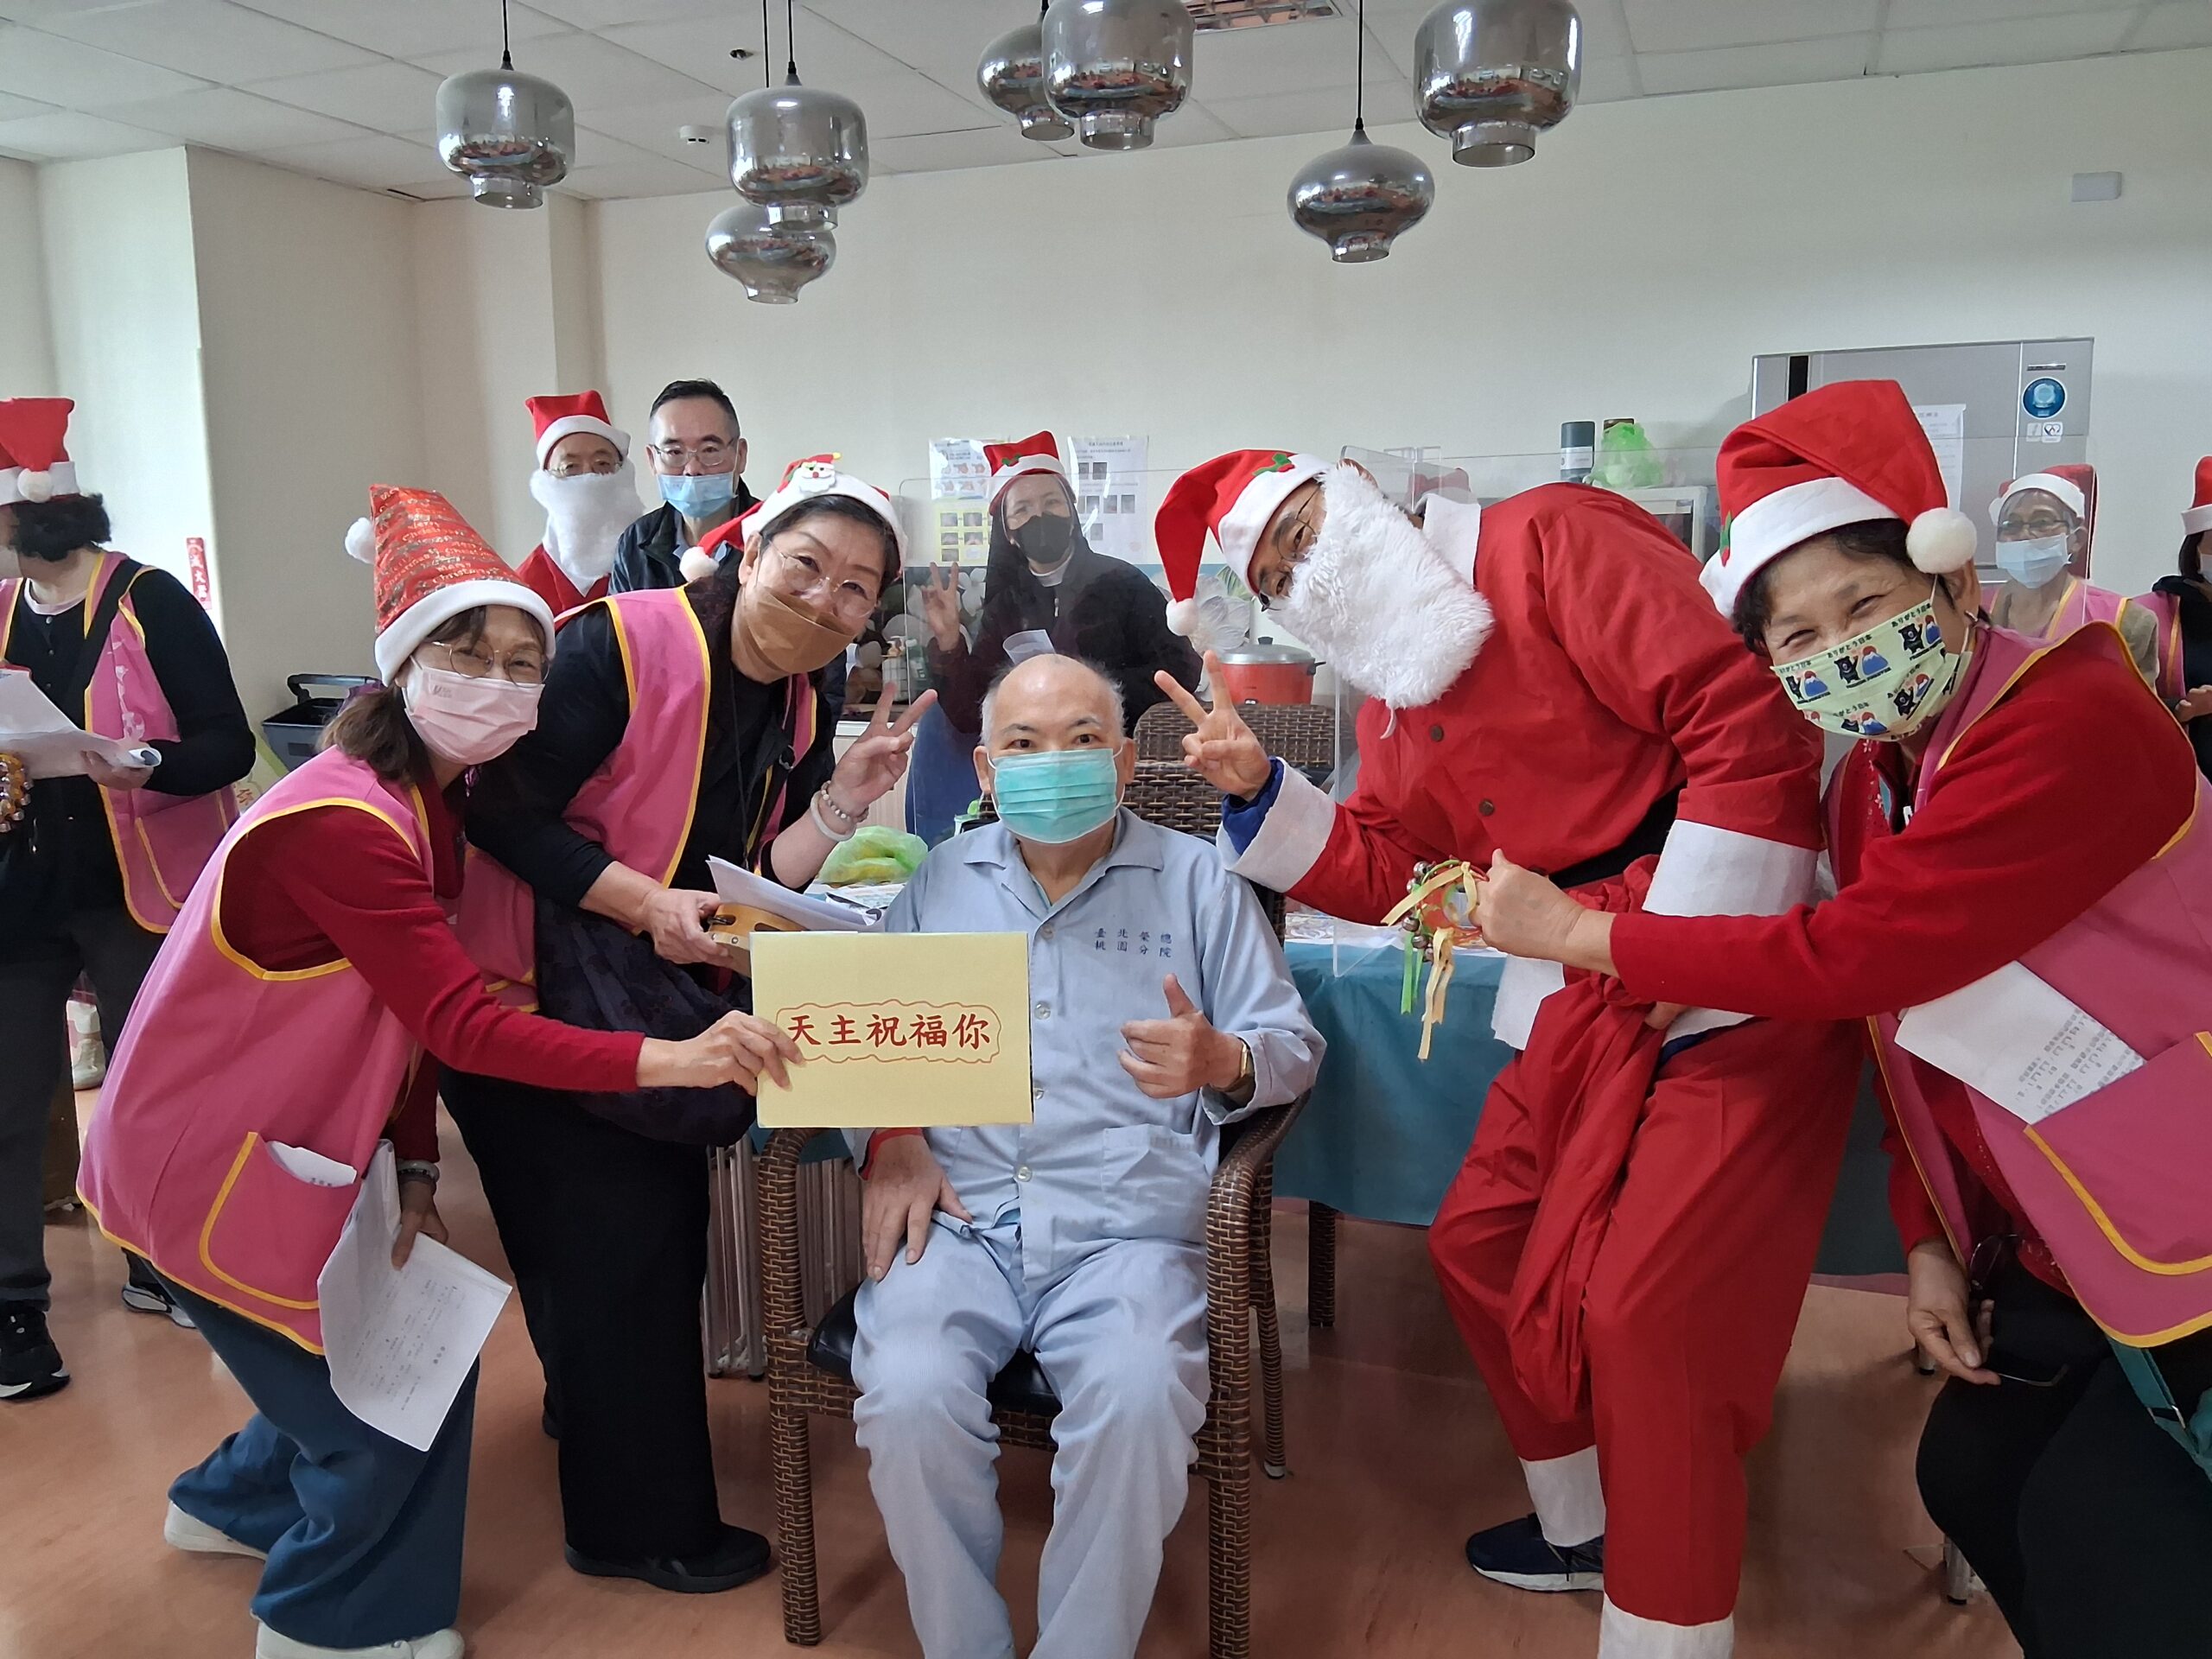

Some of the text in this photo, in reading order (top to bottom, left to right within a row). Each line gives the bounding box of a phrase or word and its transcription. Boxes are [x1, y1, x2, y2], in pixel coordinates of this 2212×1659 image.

[787, 1013, 991, 1051] 天主祝福你
